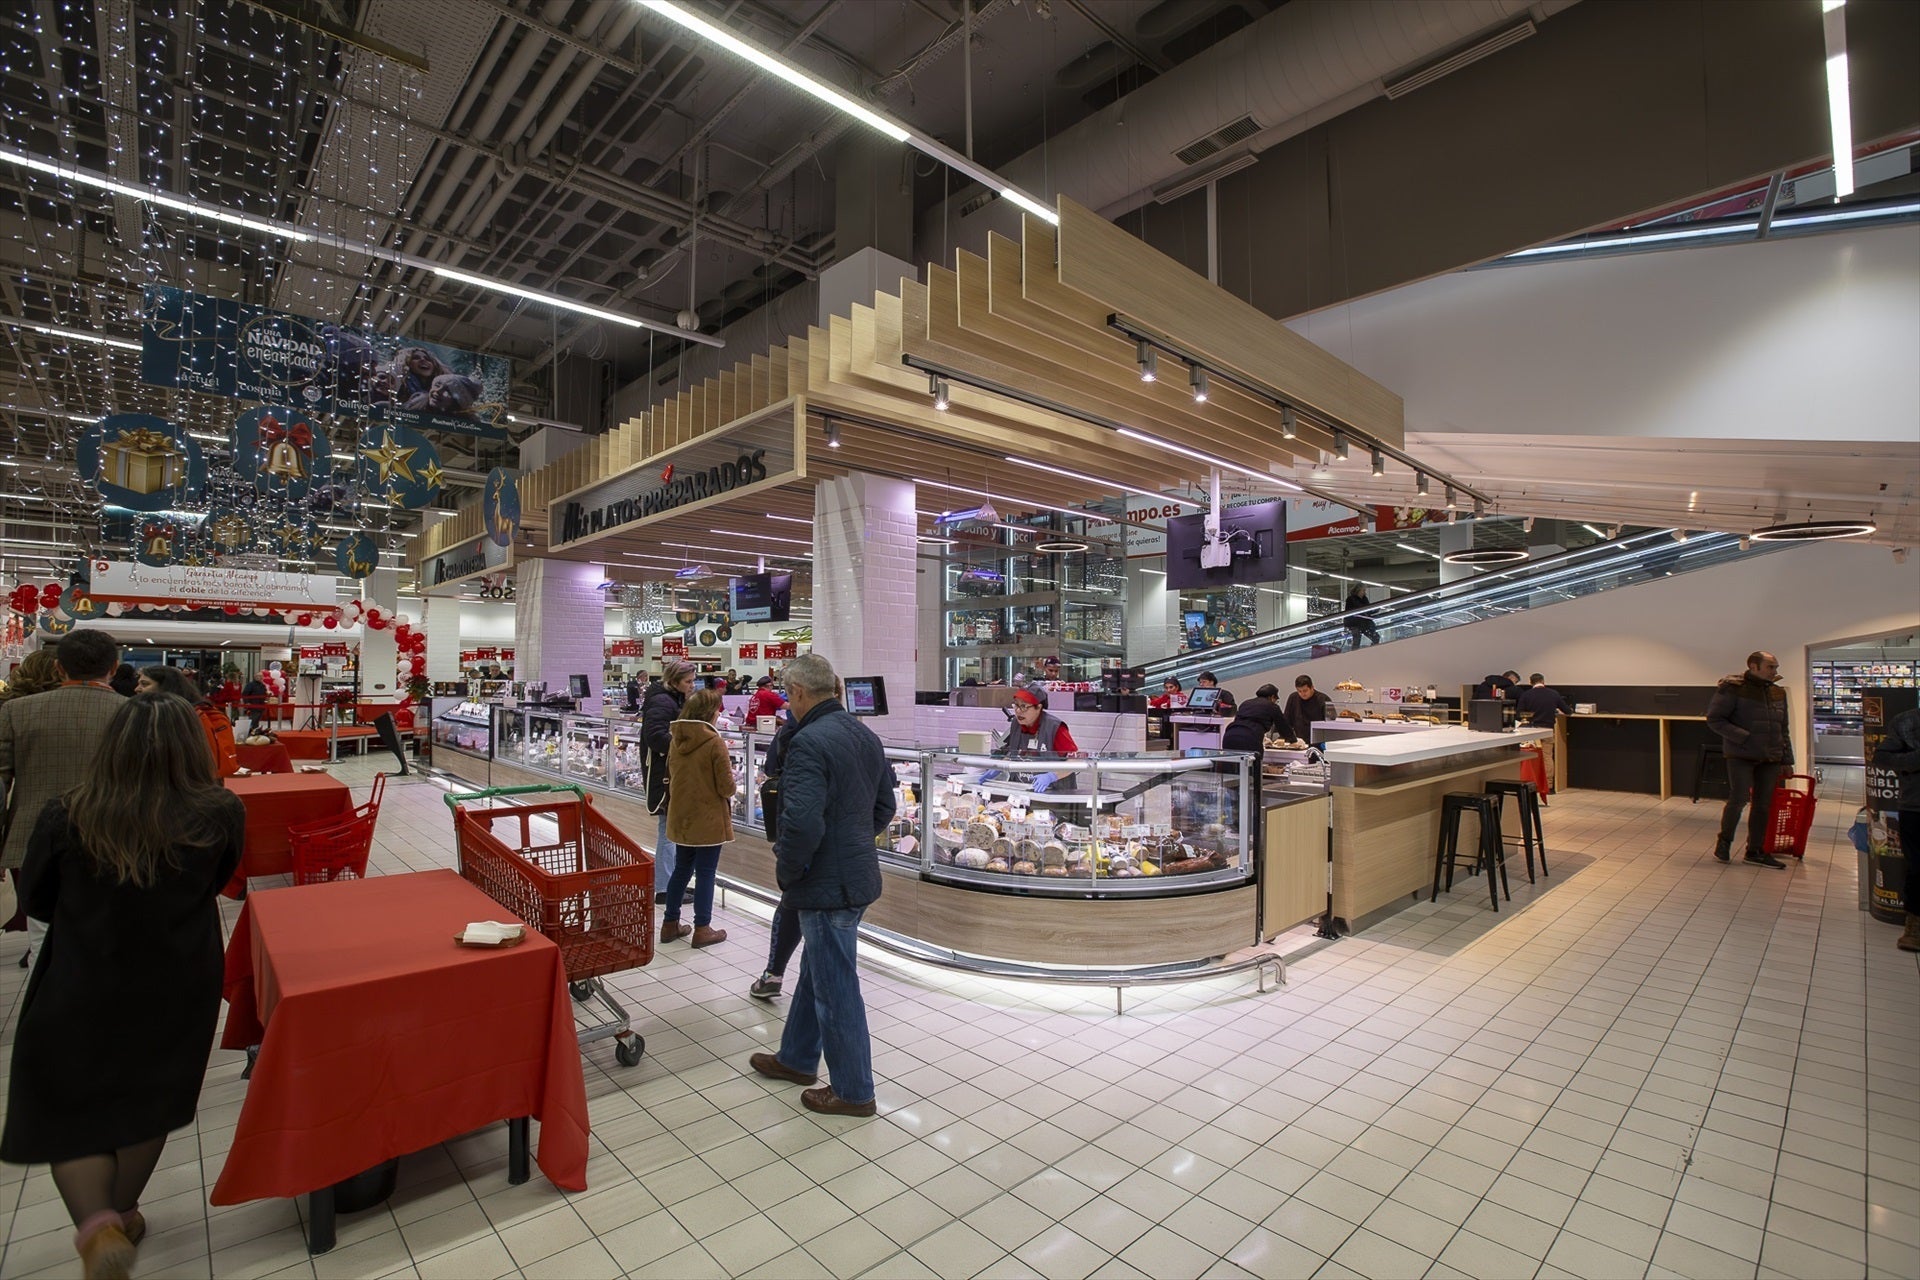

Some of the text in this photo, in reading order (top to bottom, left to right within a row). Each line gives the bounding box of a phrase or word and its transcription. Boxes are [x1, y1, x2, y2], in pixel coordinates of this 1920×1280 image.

[263, 328, 282, 338] UNA
[247, 330, 321, 356] NAVIDAD
[247, 346, 317, 369] encantada
[239, 383, 282, 397] cosmia
[338, 399, 370, 411] Qilive
[561, 449, 766, 545] Mis PLATOS PREPARADOS
[1226, 499, 1248, 509] RECOGE
[1257, 496, 1282, 505] COMPRA
[1328, 525, 1360, 535] Alcampo
[1135, 535, 1161, 546] quieras!
[151, 576, 201, 587] encuentras
[169, 585, 178, 593] el
[179, 585, 206, 594] doble
[207, 586, 219, 595] de
[221, 587, 229, 596] la
[636, 619, 664, 634] BODEGA
[1866, 766, 1897, 778] GANA
